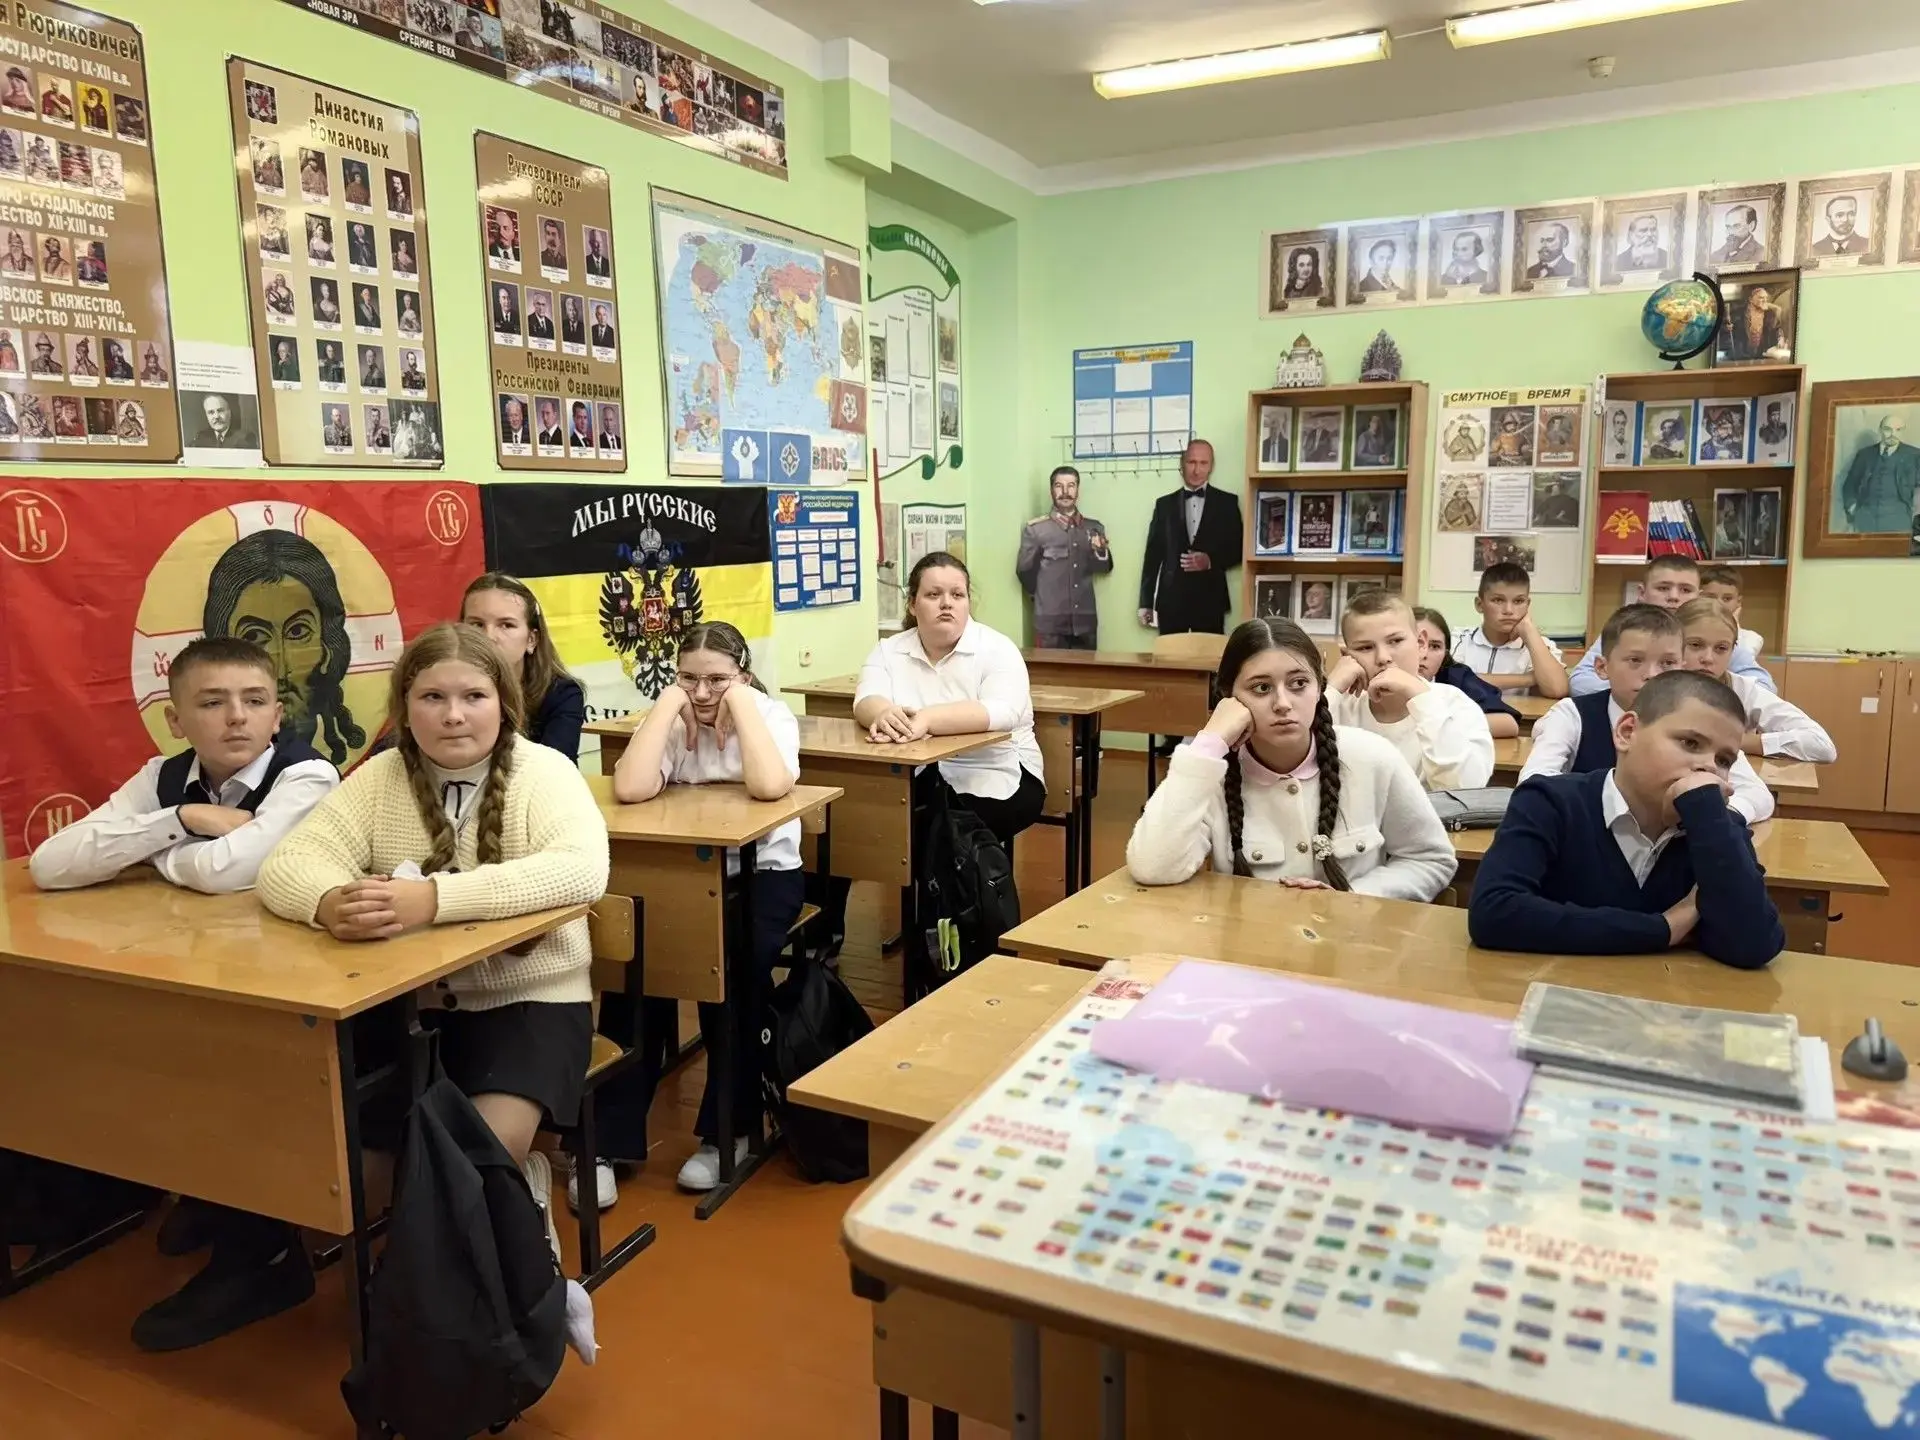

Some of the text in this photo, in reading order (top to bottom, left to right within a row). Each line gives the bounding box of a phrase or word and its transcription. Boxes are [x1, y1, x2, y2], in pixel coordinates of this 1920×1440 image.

[16, 2, 139, 61] Рюриковичей
[342, 9, 358, 25] ЭРА
[399, 30, 456, 59] СРЕДНИЕ ВЕКА
[81, 58, 111, 81] IX-XII
[314, 92, 384, 132] Династия
[309, 119, 389, 159] Романовых
[507, 152, 582, 192] Руководители
[536, 185, 564, 208] СССР
[10, 306, 69, 327] ЦАРСТВО
[73, 312, 117, 332] XIII-XVI
[50, 291, 125, 318] КНЯЖЕСТВО,
[526, 351, 590, 376] Президенты
[496, 369, 621, 399] Российской Федерации
[1450, 388, 1571, 402] СМУТНОЕ ВРЕМЯ
[812, 445, 848, 471] BRICS
[572, 492, 717, 538] МЫ РУССКИЕ
[967, 1122, 1068, 1153] АМЕРИКА
[1226, 1158, 1333, 1187] АФРИКА
[1754, 1278, 1850, 1308] КАРТА
